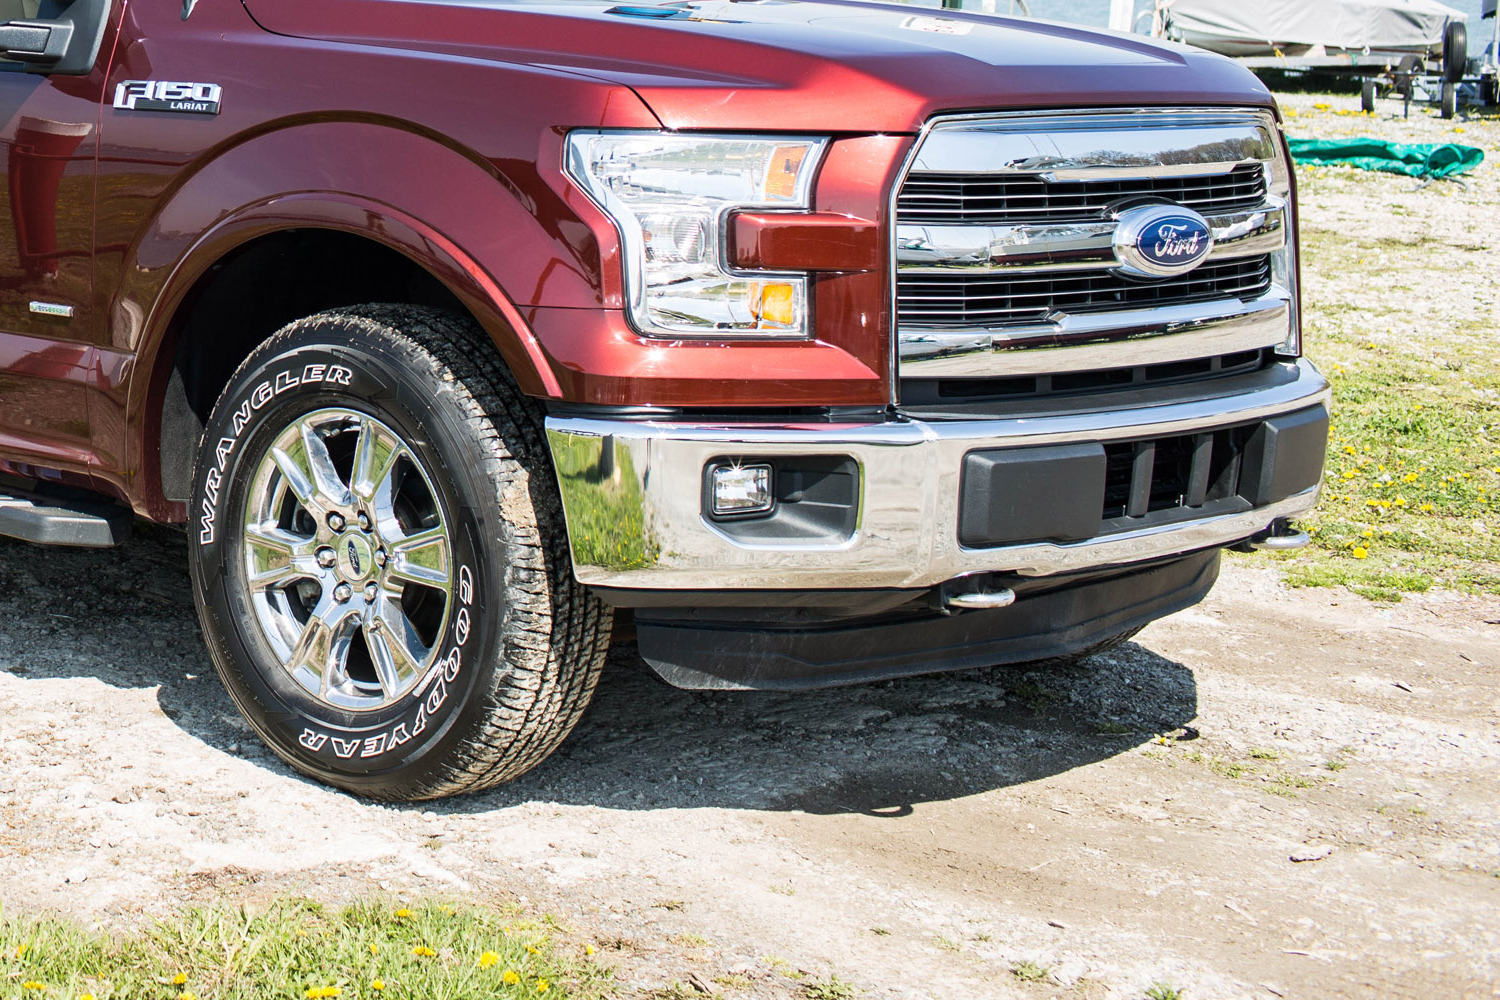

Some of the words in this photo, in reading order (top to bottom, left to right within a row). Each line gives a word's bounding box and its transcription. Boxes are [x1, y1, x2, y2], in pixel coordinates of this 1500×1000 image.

[170, 102, 208, 111] LARIAT
[1155, 224, 1200, 258] Ford
[200, 364, 353, 546] WRANGLER
[299, 564, 474, 759] GOODYEAR
